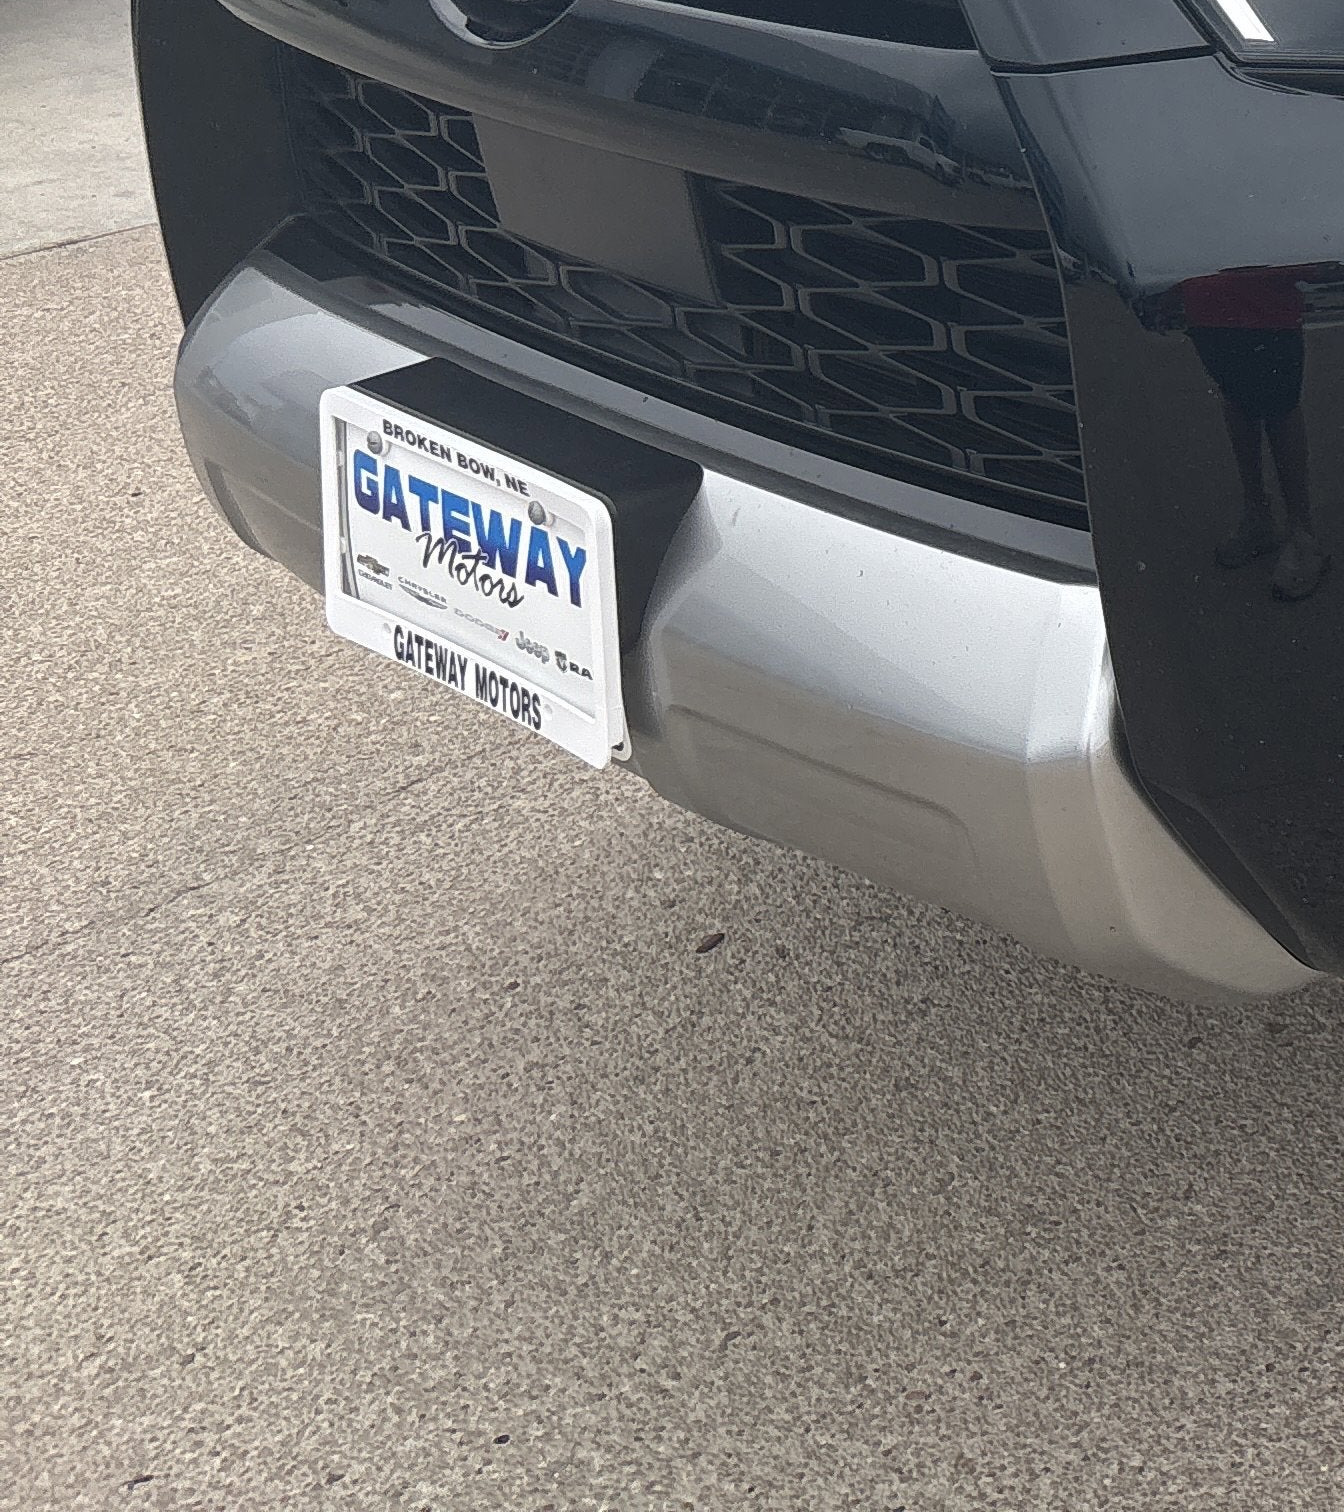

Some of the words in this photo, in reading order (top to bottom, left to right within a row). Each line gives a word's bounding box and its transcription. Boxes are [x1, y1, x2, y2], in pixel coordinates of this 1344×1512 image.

[382, 418, 453, 464] BROKEN
[457, 451, 502, 487] BOW,
[505, 474, 531, 498] NE
[353, 448, 587, 609] GATEWAY
[415, 532, 525, 609] Motors
[393, 624, 468, 691] GATEWAY
[475, 662, 542, 731] MOTORS
[515, 630, 550, 665] Jeep
